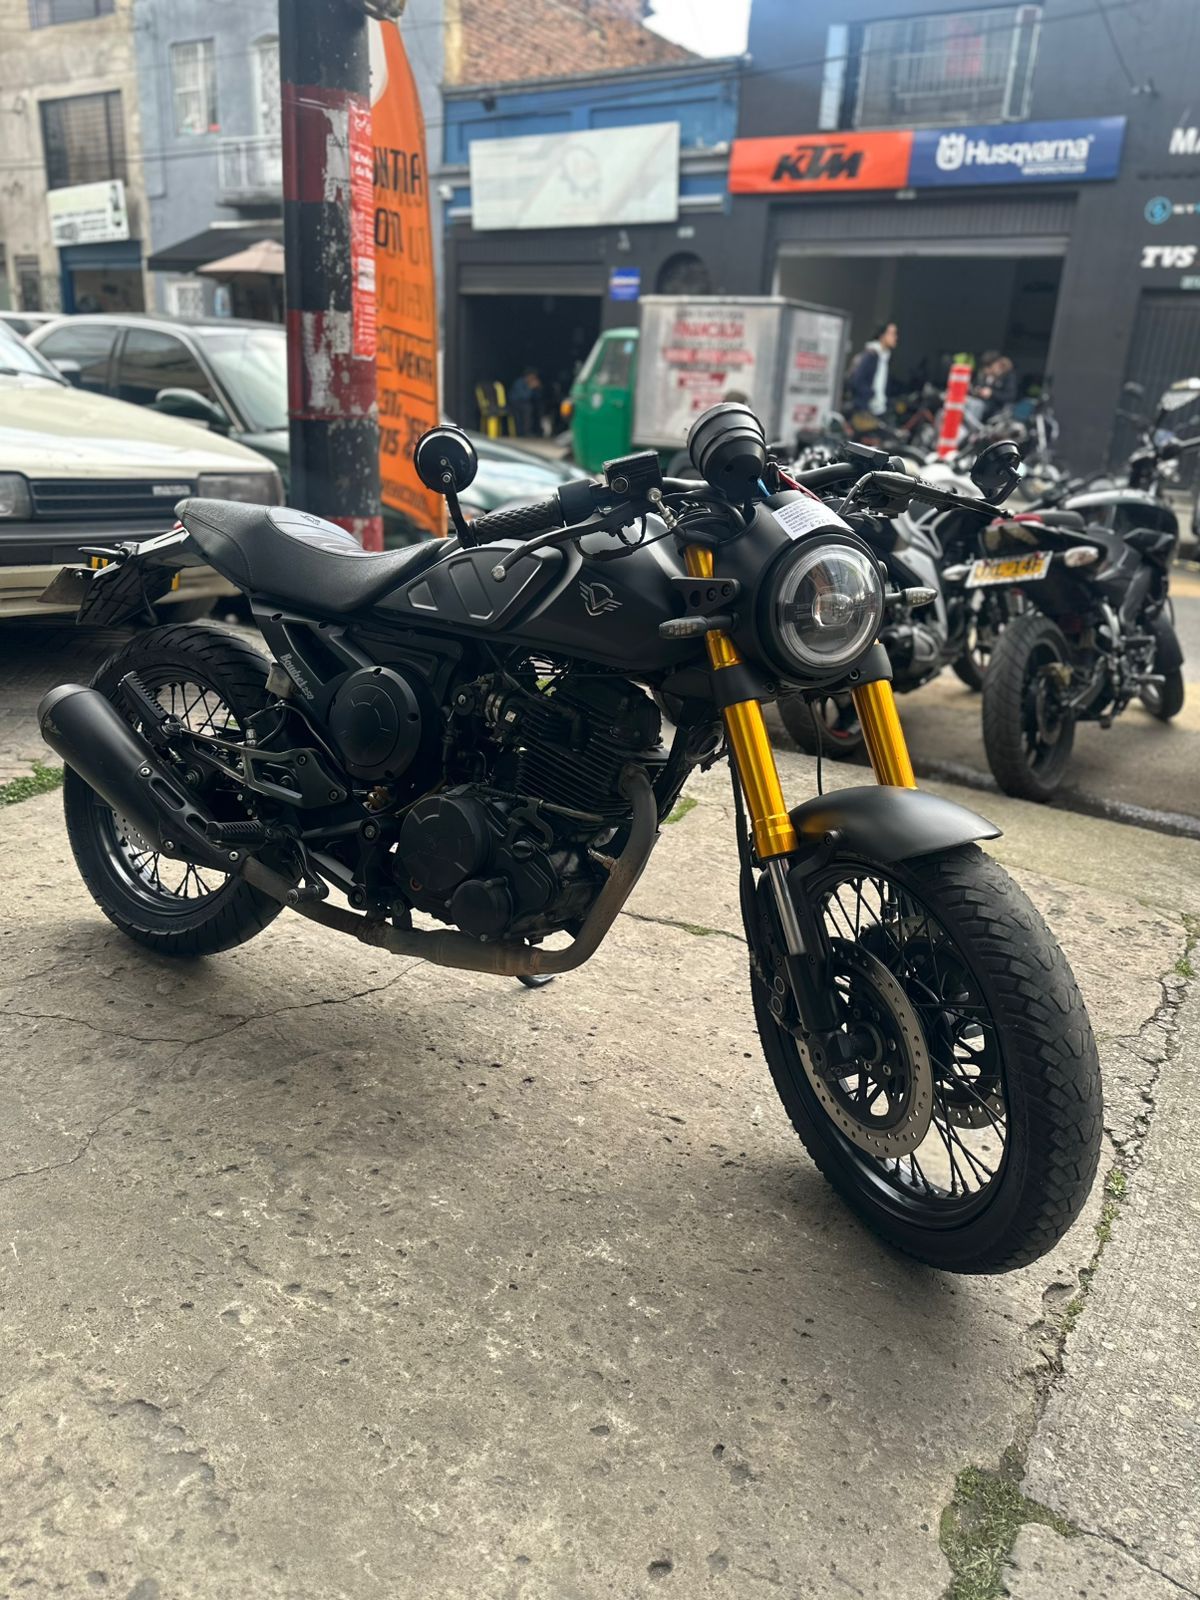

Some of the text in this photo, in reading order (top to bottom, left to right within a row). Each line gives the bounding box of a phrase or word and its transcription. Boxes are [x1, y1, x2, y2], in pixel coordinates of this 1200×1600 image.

[964, 139, 1089, 167] Husqvarna
[1169, 126, 1200, 155] M
[771, 144, 863, 180] KTM
[1140, 245, 1198, 268] TVS
